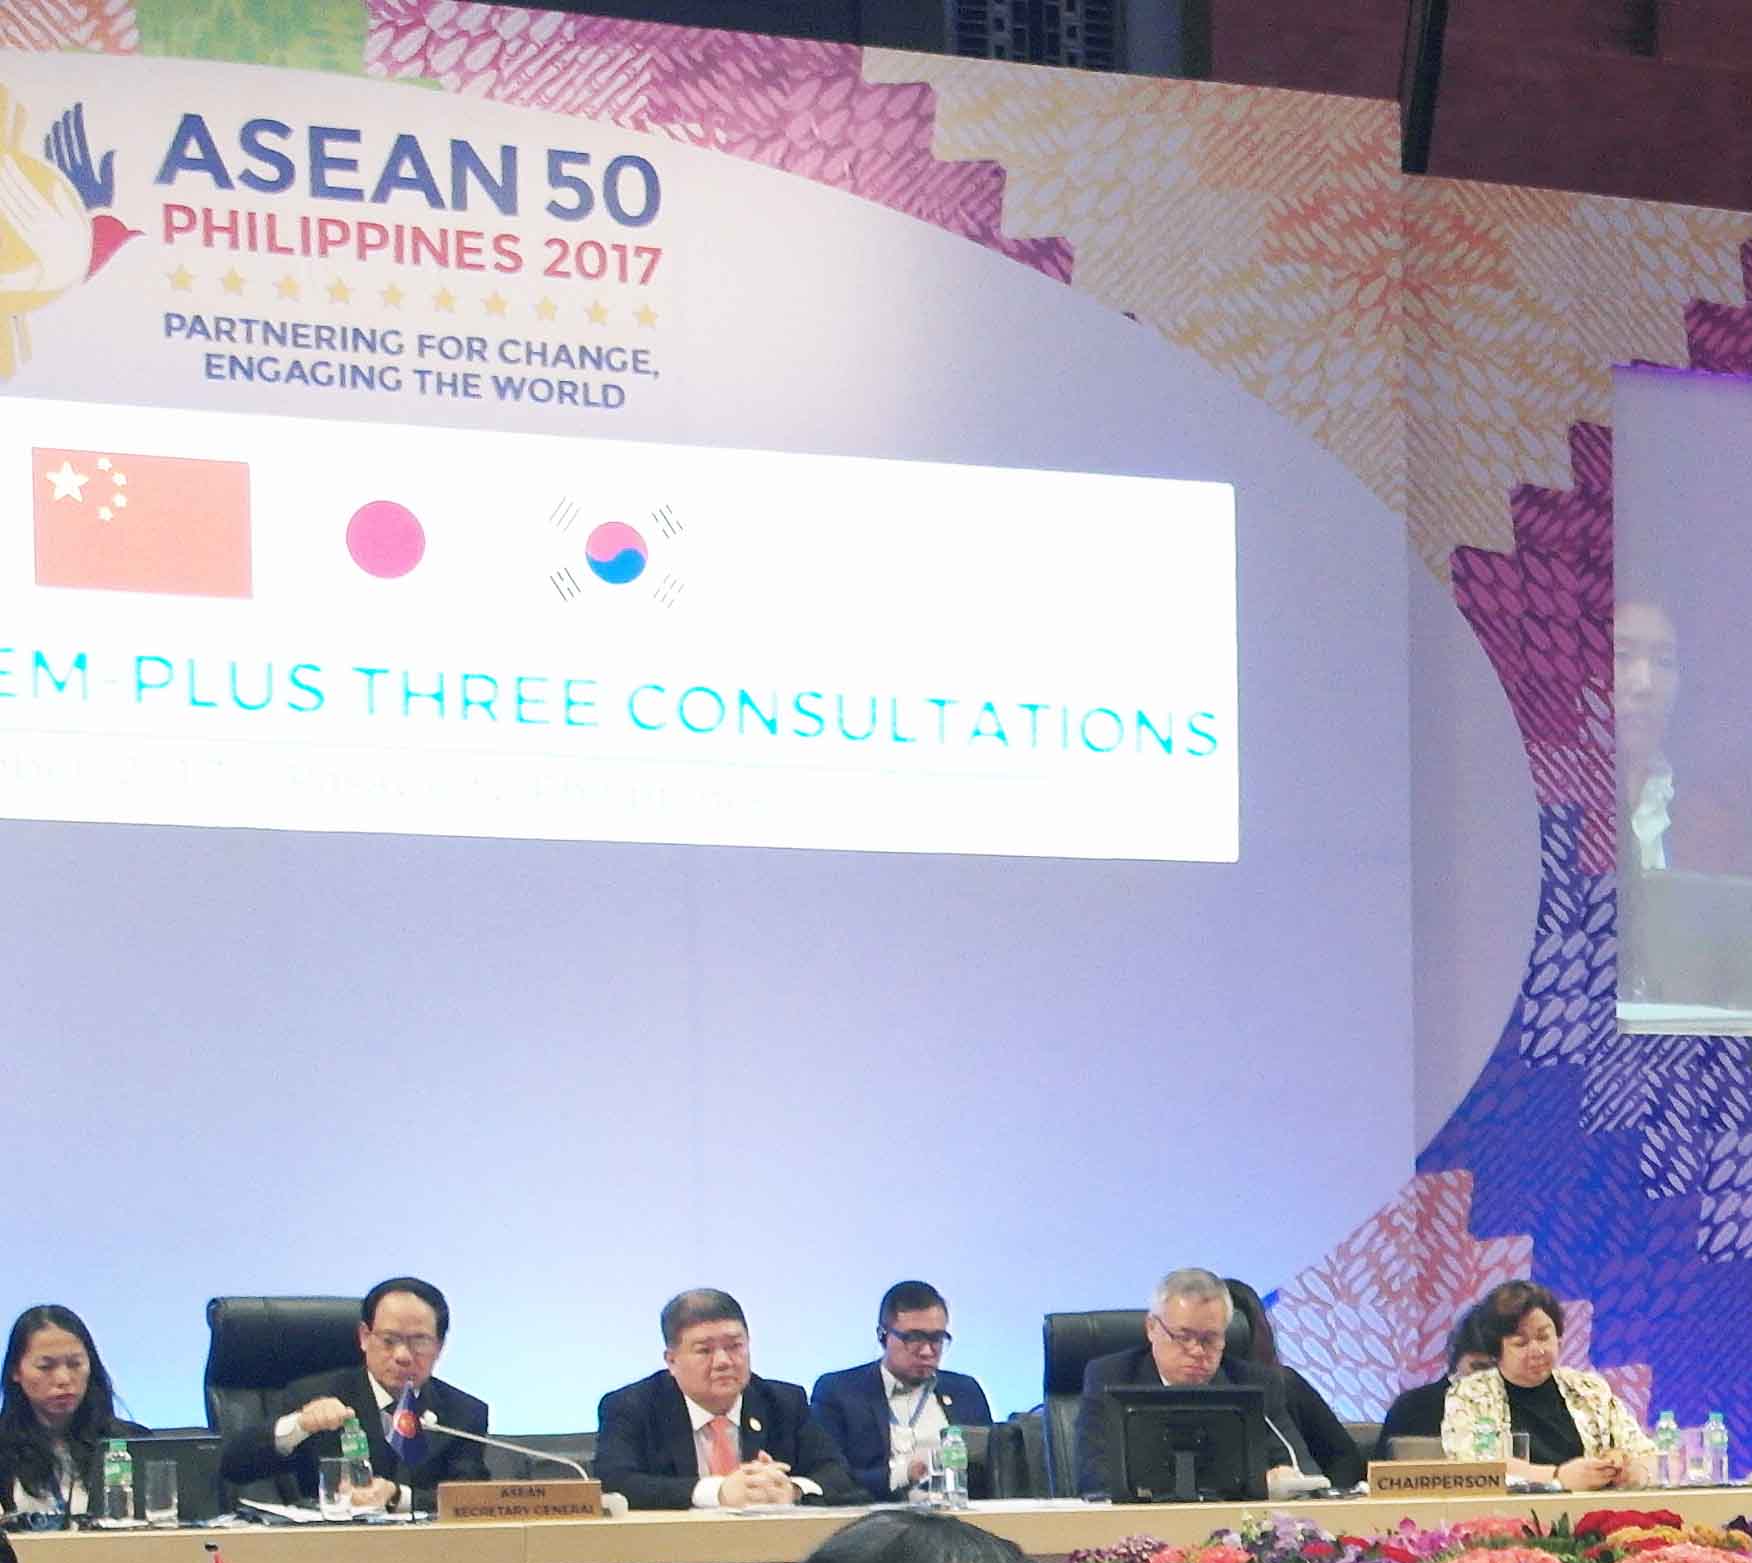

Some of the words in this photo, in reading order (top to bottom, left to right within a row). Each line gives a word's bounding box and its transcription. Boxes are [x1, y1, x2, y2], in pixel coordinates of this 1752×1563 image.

[154, 113, 518, 217] ASEAN
[546, 149, 661, 227] 50
[162, 203, 524, 273] PHILIPPINES
[543, 237, 663, 285] 2017
[164, 312, 404, 355] PARTNERING
[418, 334, 488, 362] FOR
[499, 338, 660, 379] CHANGE,
[205, 352, 402, 392] ENGAGING
[413, 369, 482, 400] THE
[492, 375, 626, 409] WORLD
[352, 667, 599, 727] THREE
[627, 683, 1219, 757] CONSULTATIONS
[453, 1502, 529, 1517] SECRETARY
[533, 1503, 594, 1516] GENERAL
[501, 1487, 545, 1498] ASEAN
[1377, 1474, 1500, 1490] CHAIRPERSON
